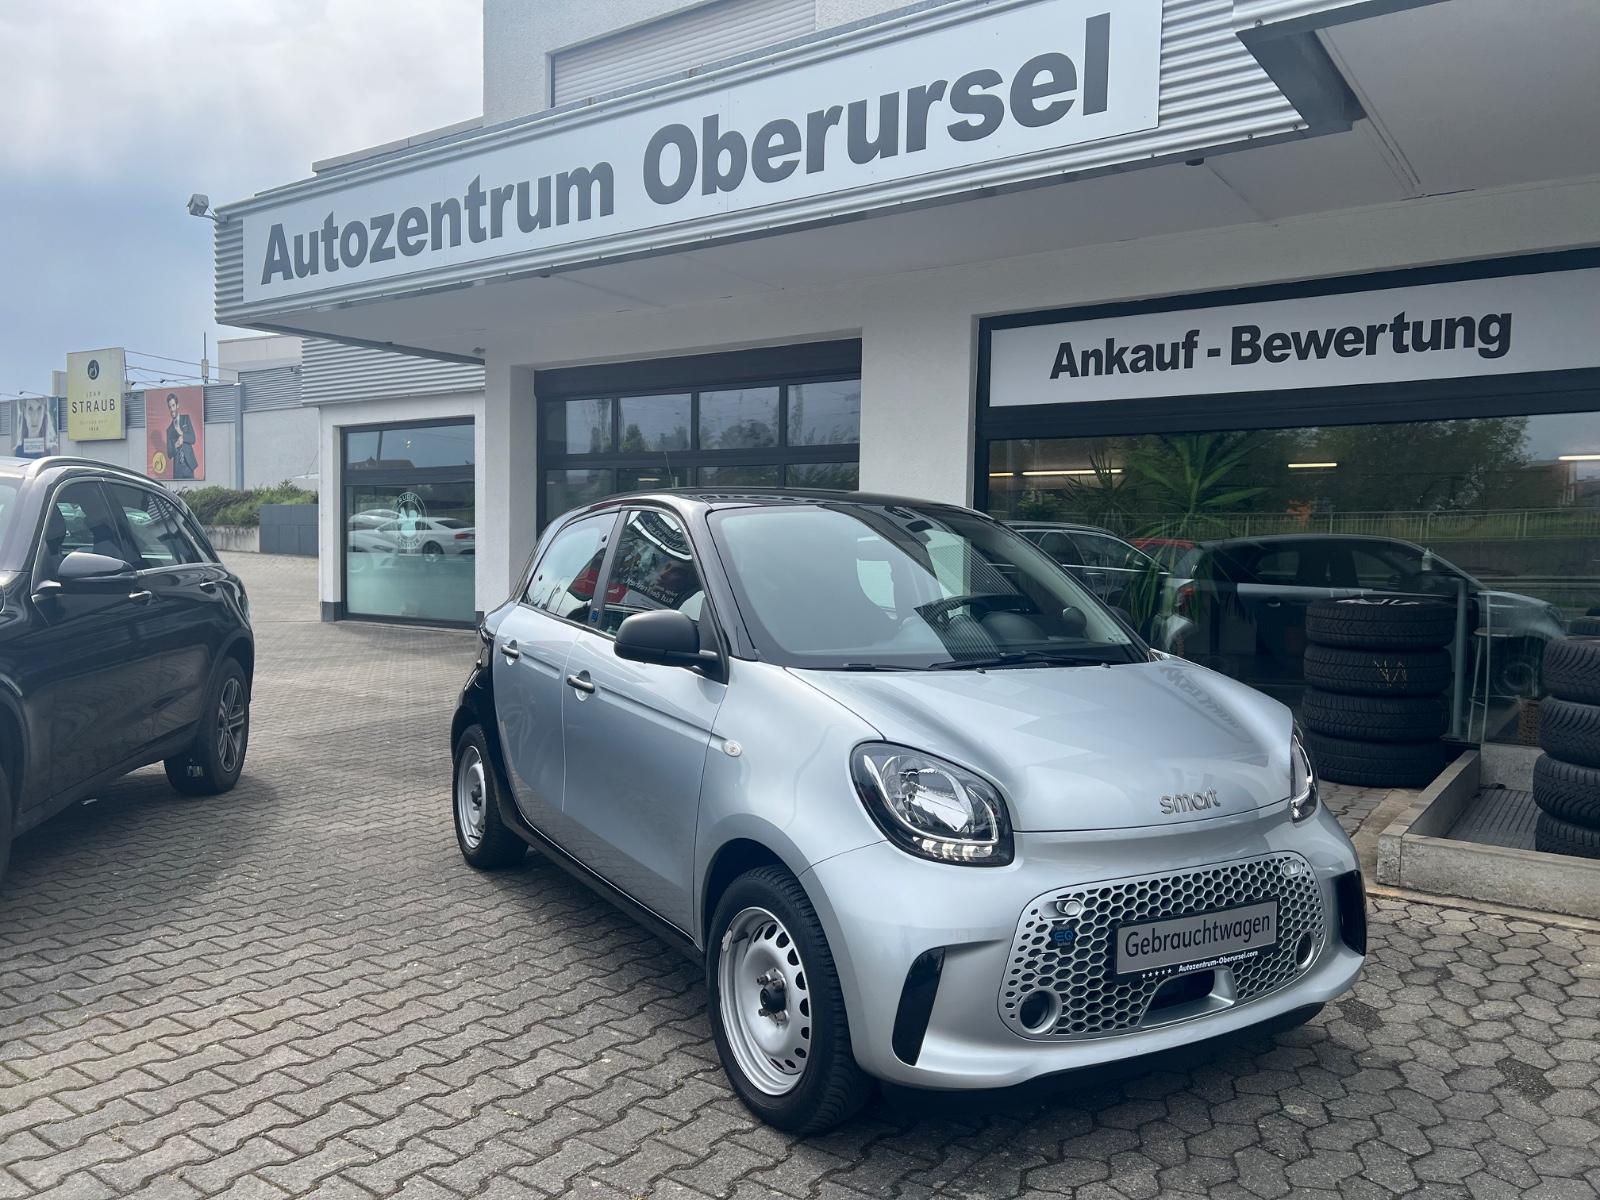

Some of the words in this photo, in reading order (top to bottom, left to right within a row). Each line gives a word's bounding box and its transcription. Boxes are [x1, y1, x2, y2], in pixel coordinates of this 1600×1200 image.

[261, 161, 615, 285] Autozentrum
[643, 12, 1110, 205] Oberursel
[1049, 329, 1201, 380] Ankauf
[1230, 311, 1513, 366] Bewertung
[71, 398, 116, 414] STRAUB
[1159, 787, 1221, 815] smart
[1054, 930, 1074, 942] EQ
[1125, 914, 1270, 957] Gebrauchtwagen
